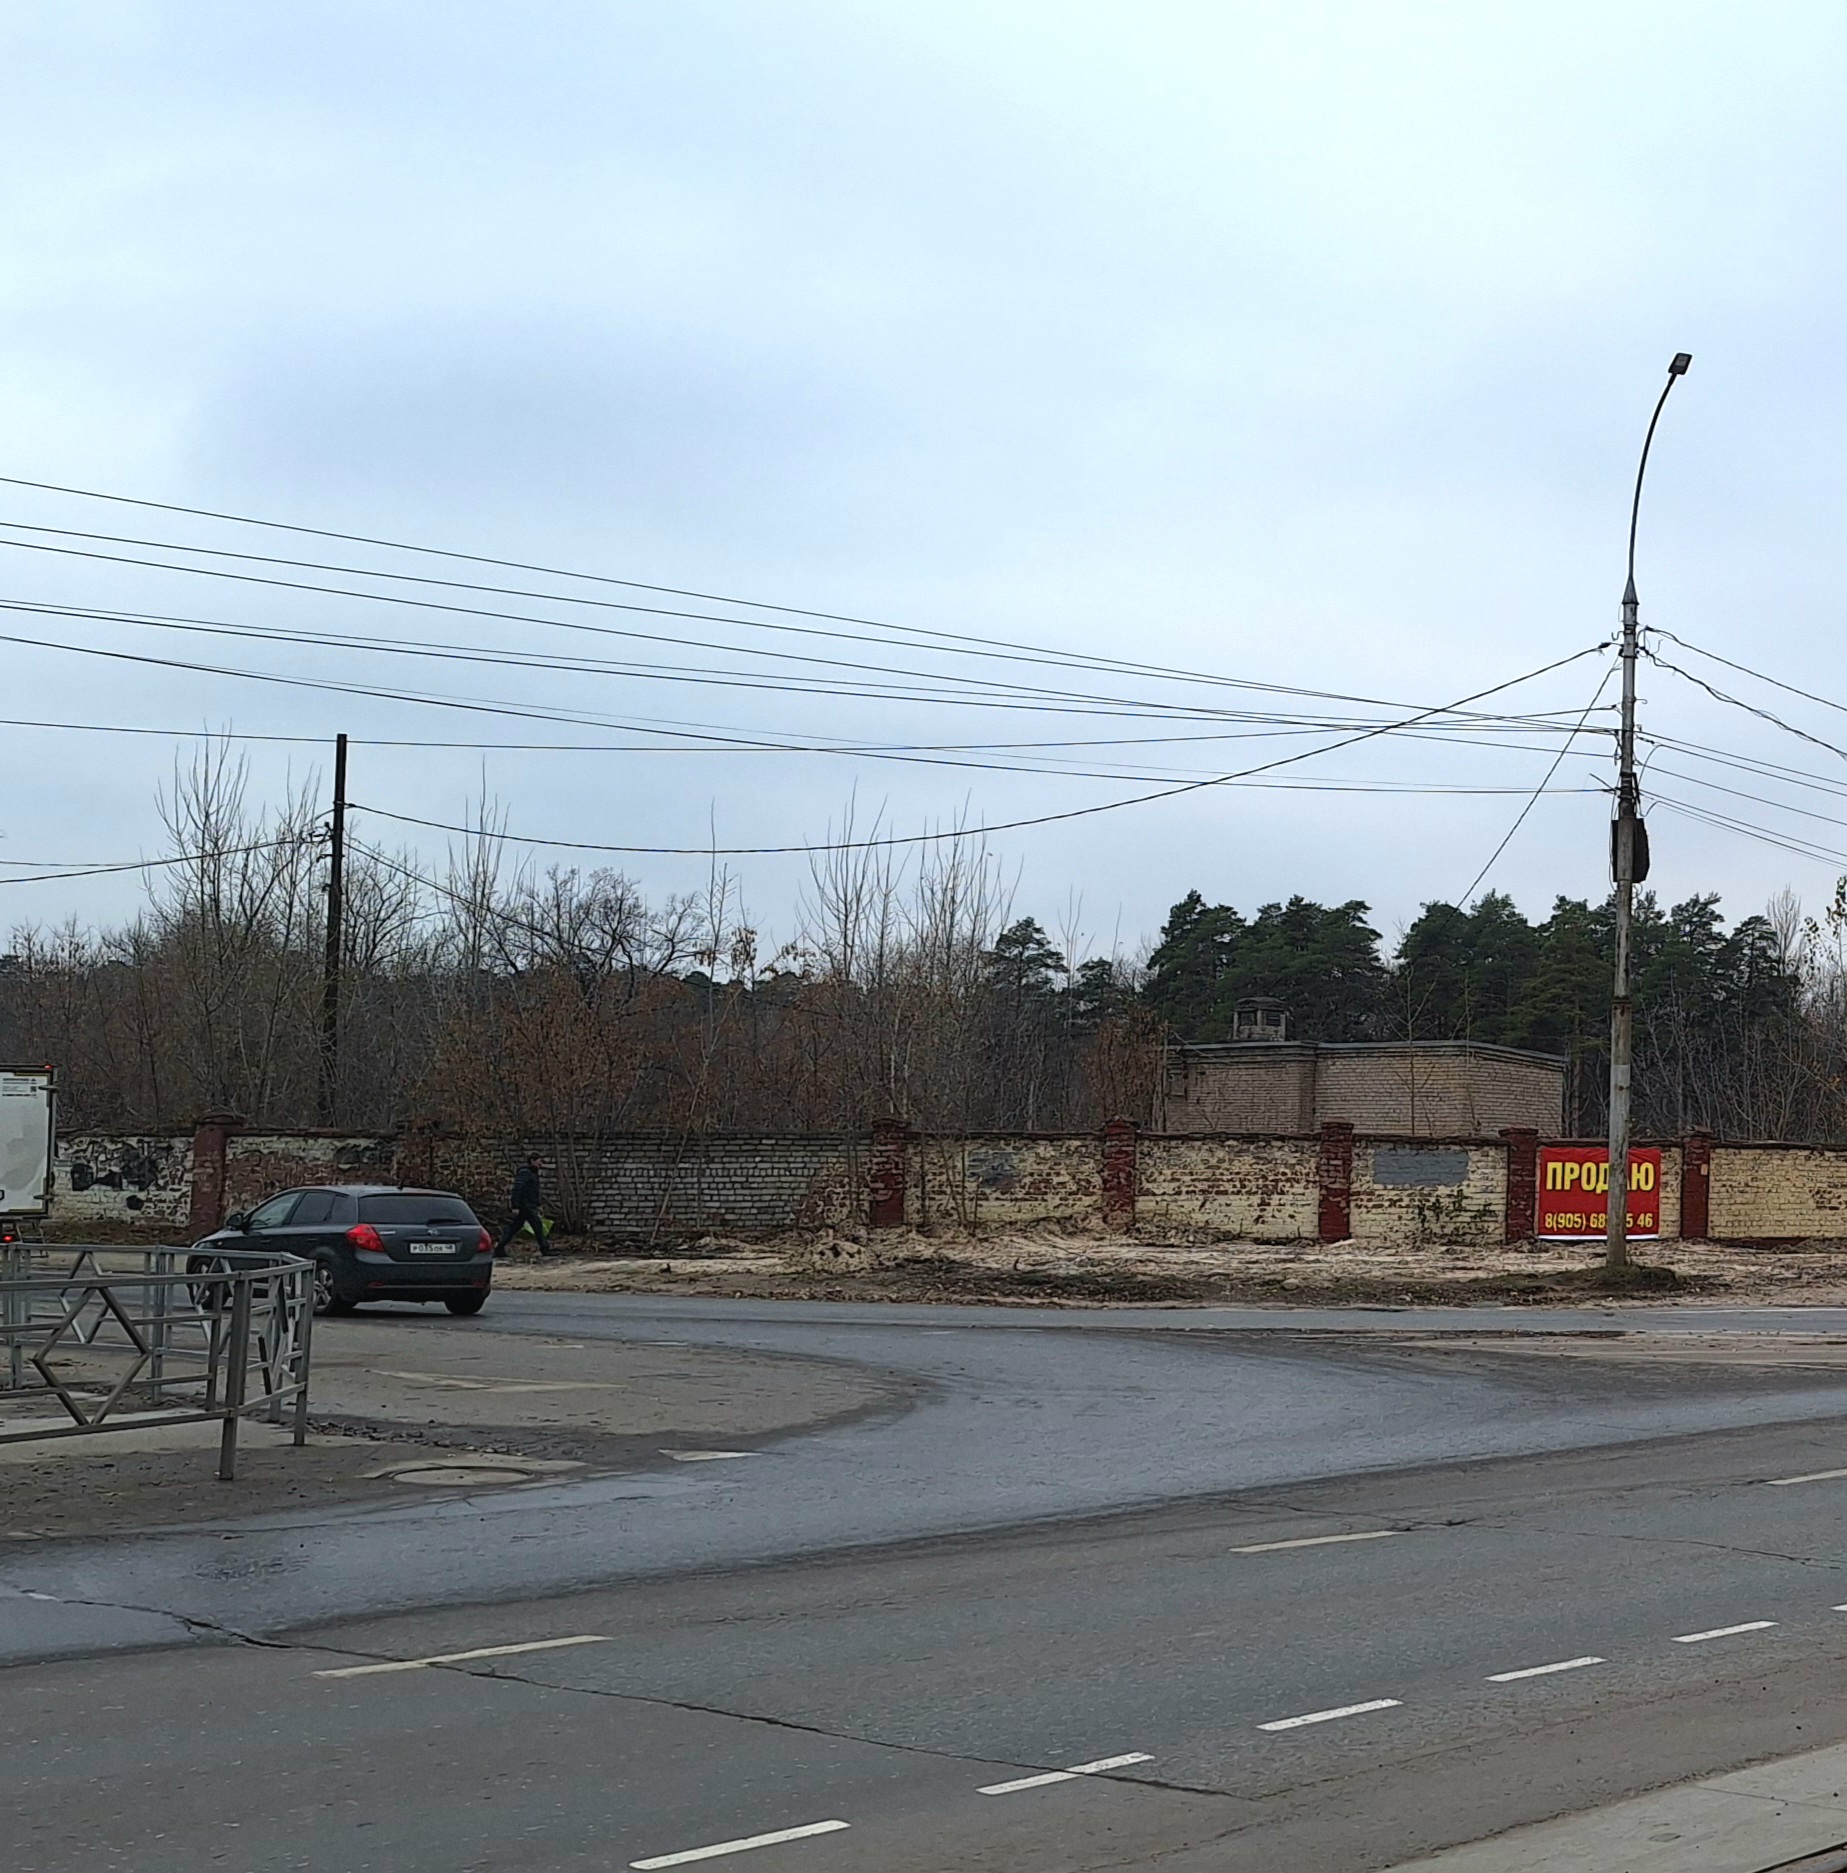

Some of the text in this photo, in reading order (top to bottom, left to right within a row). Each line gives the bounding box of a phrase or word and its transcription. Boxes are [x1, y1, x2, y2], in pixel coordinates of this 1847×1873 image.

[1546, 1161, 1655, 1194] ПРОДЮ
[1545, 1212, 1586, 1231] 8(905)
[1589, 1212, 1608, 1228] 68
[1636, 1212, 1653, 1228] 46
